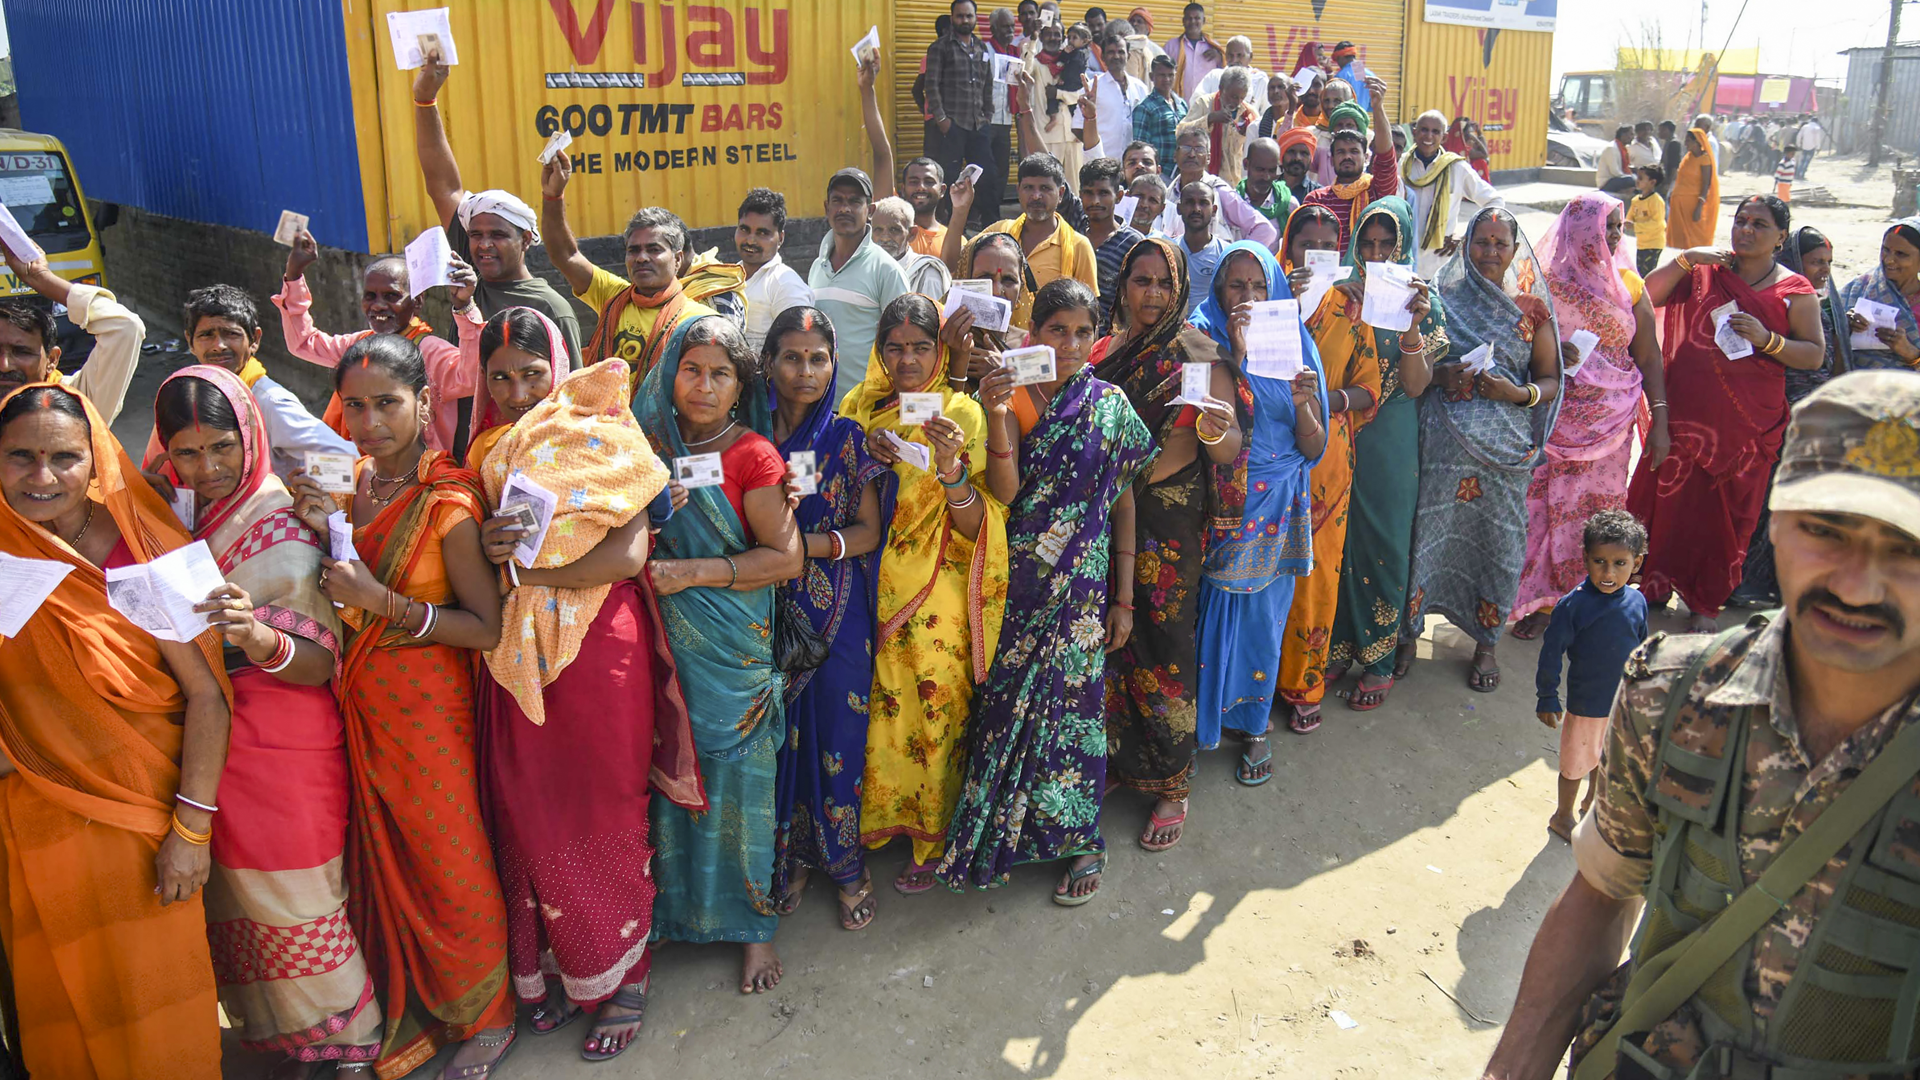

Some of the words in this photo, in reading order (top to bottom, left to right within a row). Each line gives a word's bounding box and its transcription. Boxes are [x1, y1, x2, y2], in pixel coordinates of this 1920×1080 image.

[547, 0, 788, 88] Vijay
[700, 102, 783, 132] BARS
[1448, 75, 1518, 131] Vijay
[570, 152, 602, 174] HE
[614, 146, 716, 173] MODERN
[726, 143, 797, 164] STEEL
[1487, 139, 1512, 155] BARS
